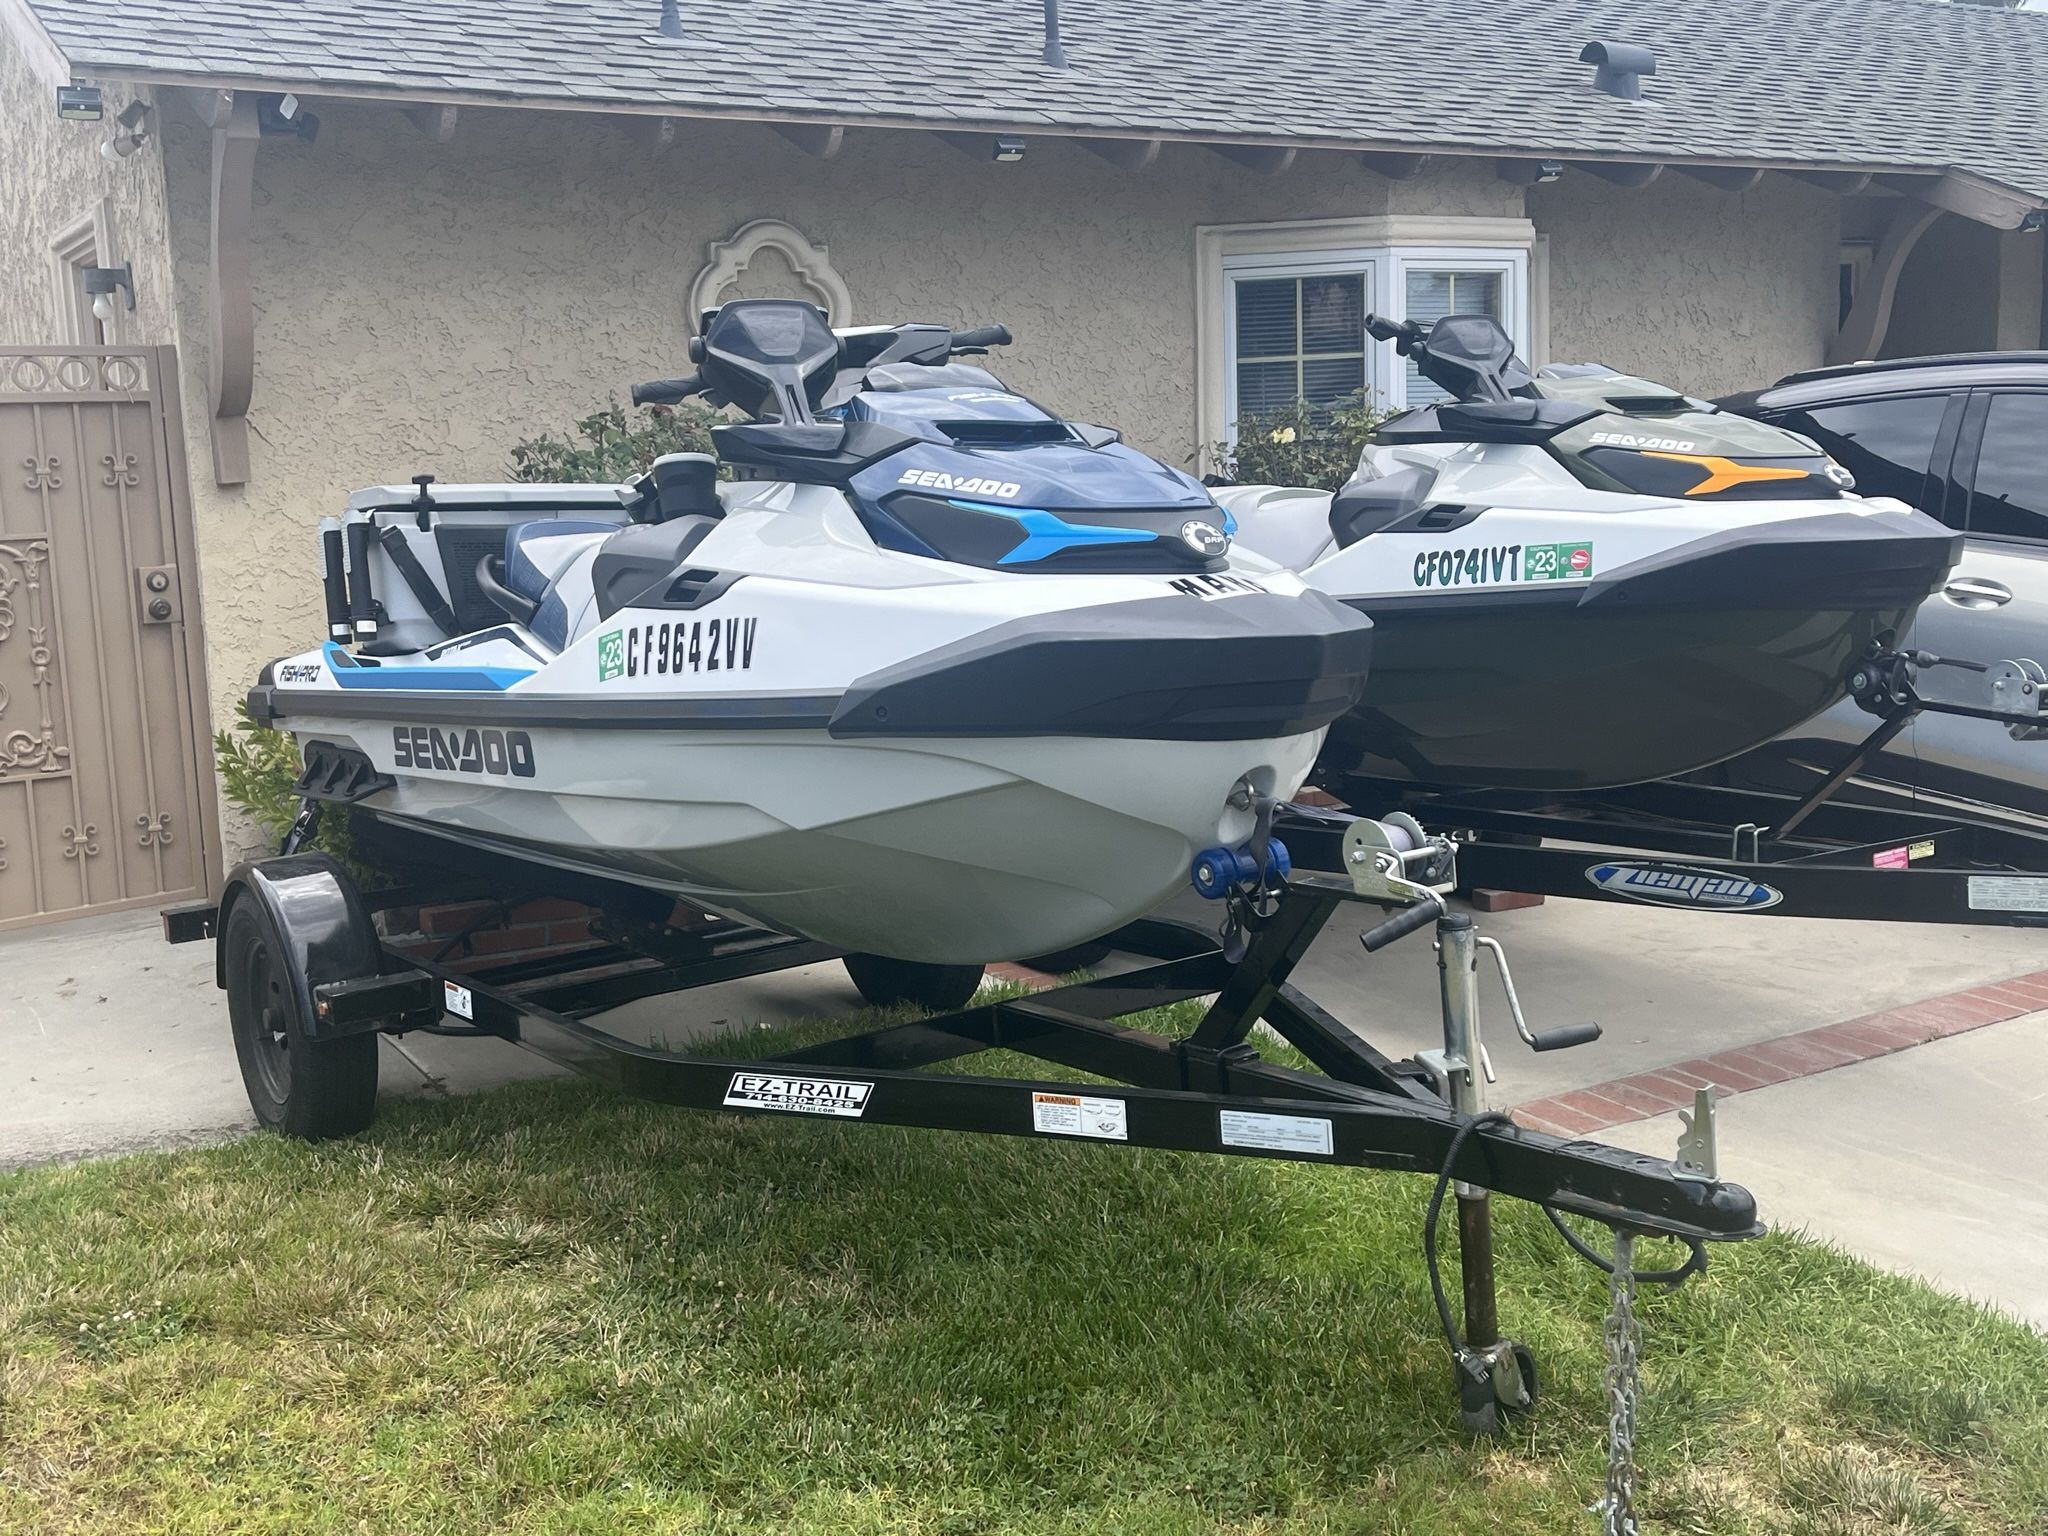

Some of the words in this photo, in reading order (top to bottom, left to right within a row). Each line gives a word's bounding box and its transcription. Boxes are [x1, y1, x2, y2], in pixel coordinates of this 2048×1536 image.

[1413, 545, 1522, 587] CF0741VT
[1535, 551, 1557, 573] 23
[606, 639, 622, 669] 23
[627, 617, 757, 678] CF9642VV
[741, 1077, 858, 1100] EZ-TRAIL
